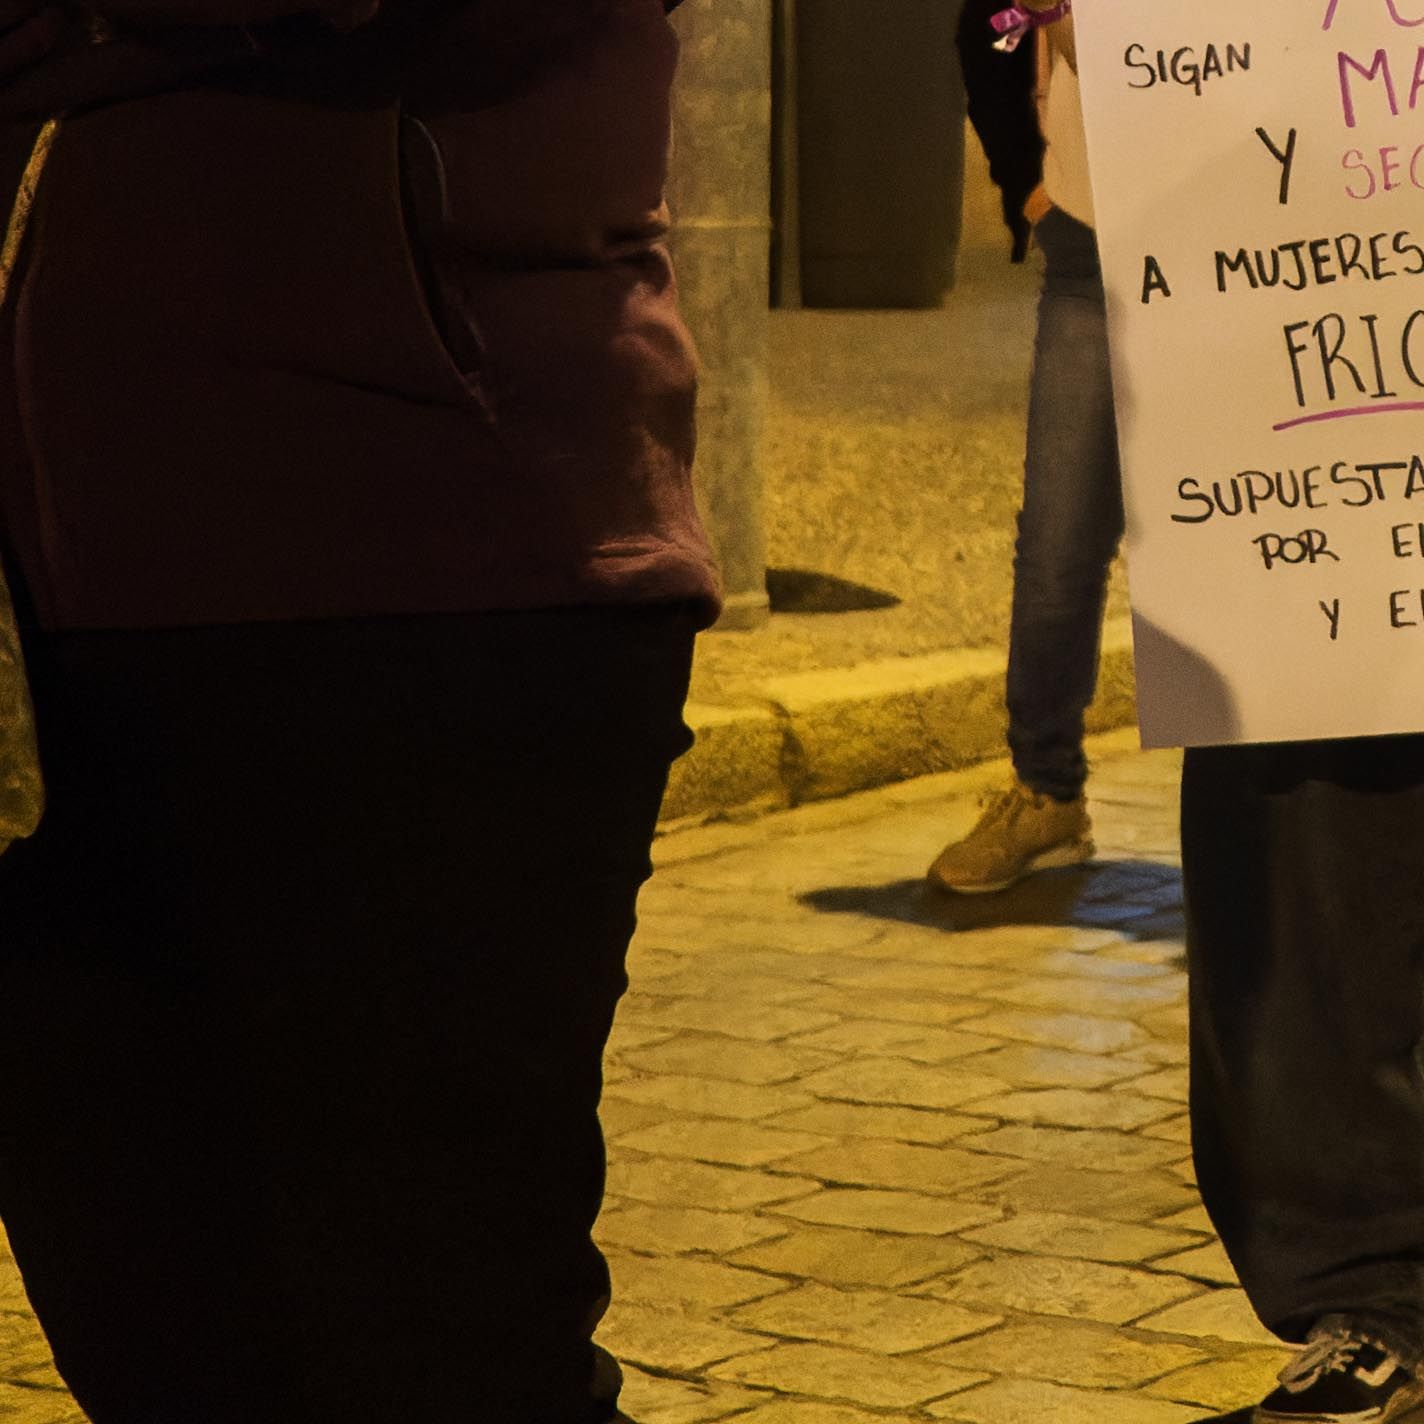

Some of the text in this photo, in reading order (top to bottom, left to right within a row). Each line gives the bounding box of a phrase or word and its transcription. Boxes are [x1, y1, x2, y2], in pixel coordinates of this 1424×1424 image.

[1122, 40, 1254, 96] SIGAN
[1254, 126, 1298, 206] Y
[1140, 254, 1172, 304] A
[1252, 526, 1340, 570] POR
[1320, 596, 1342, 640] Y
